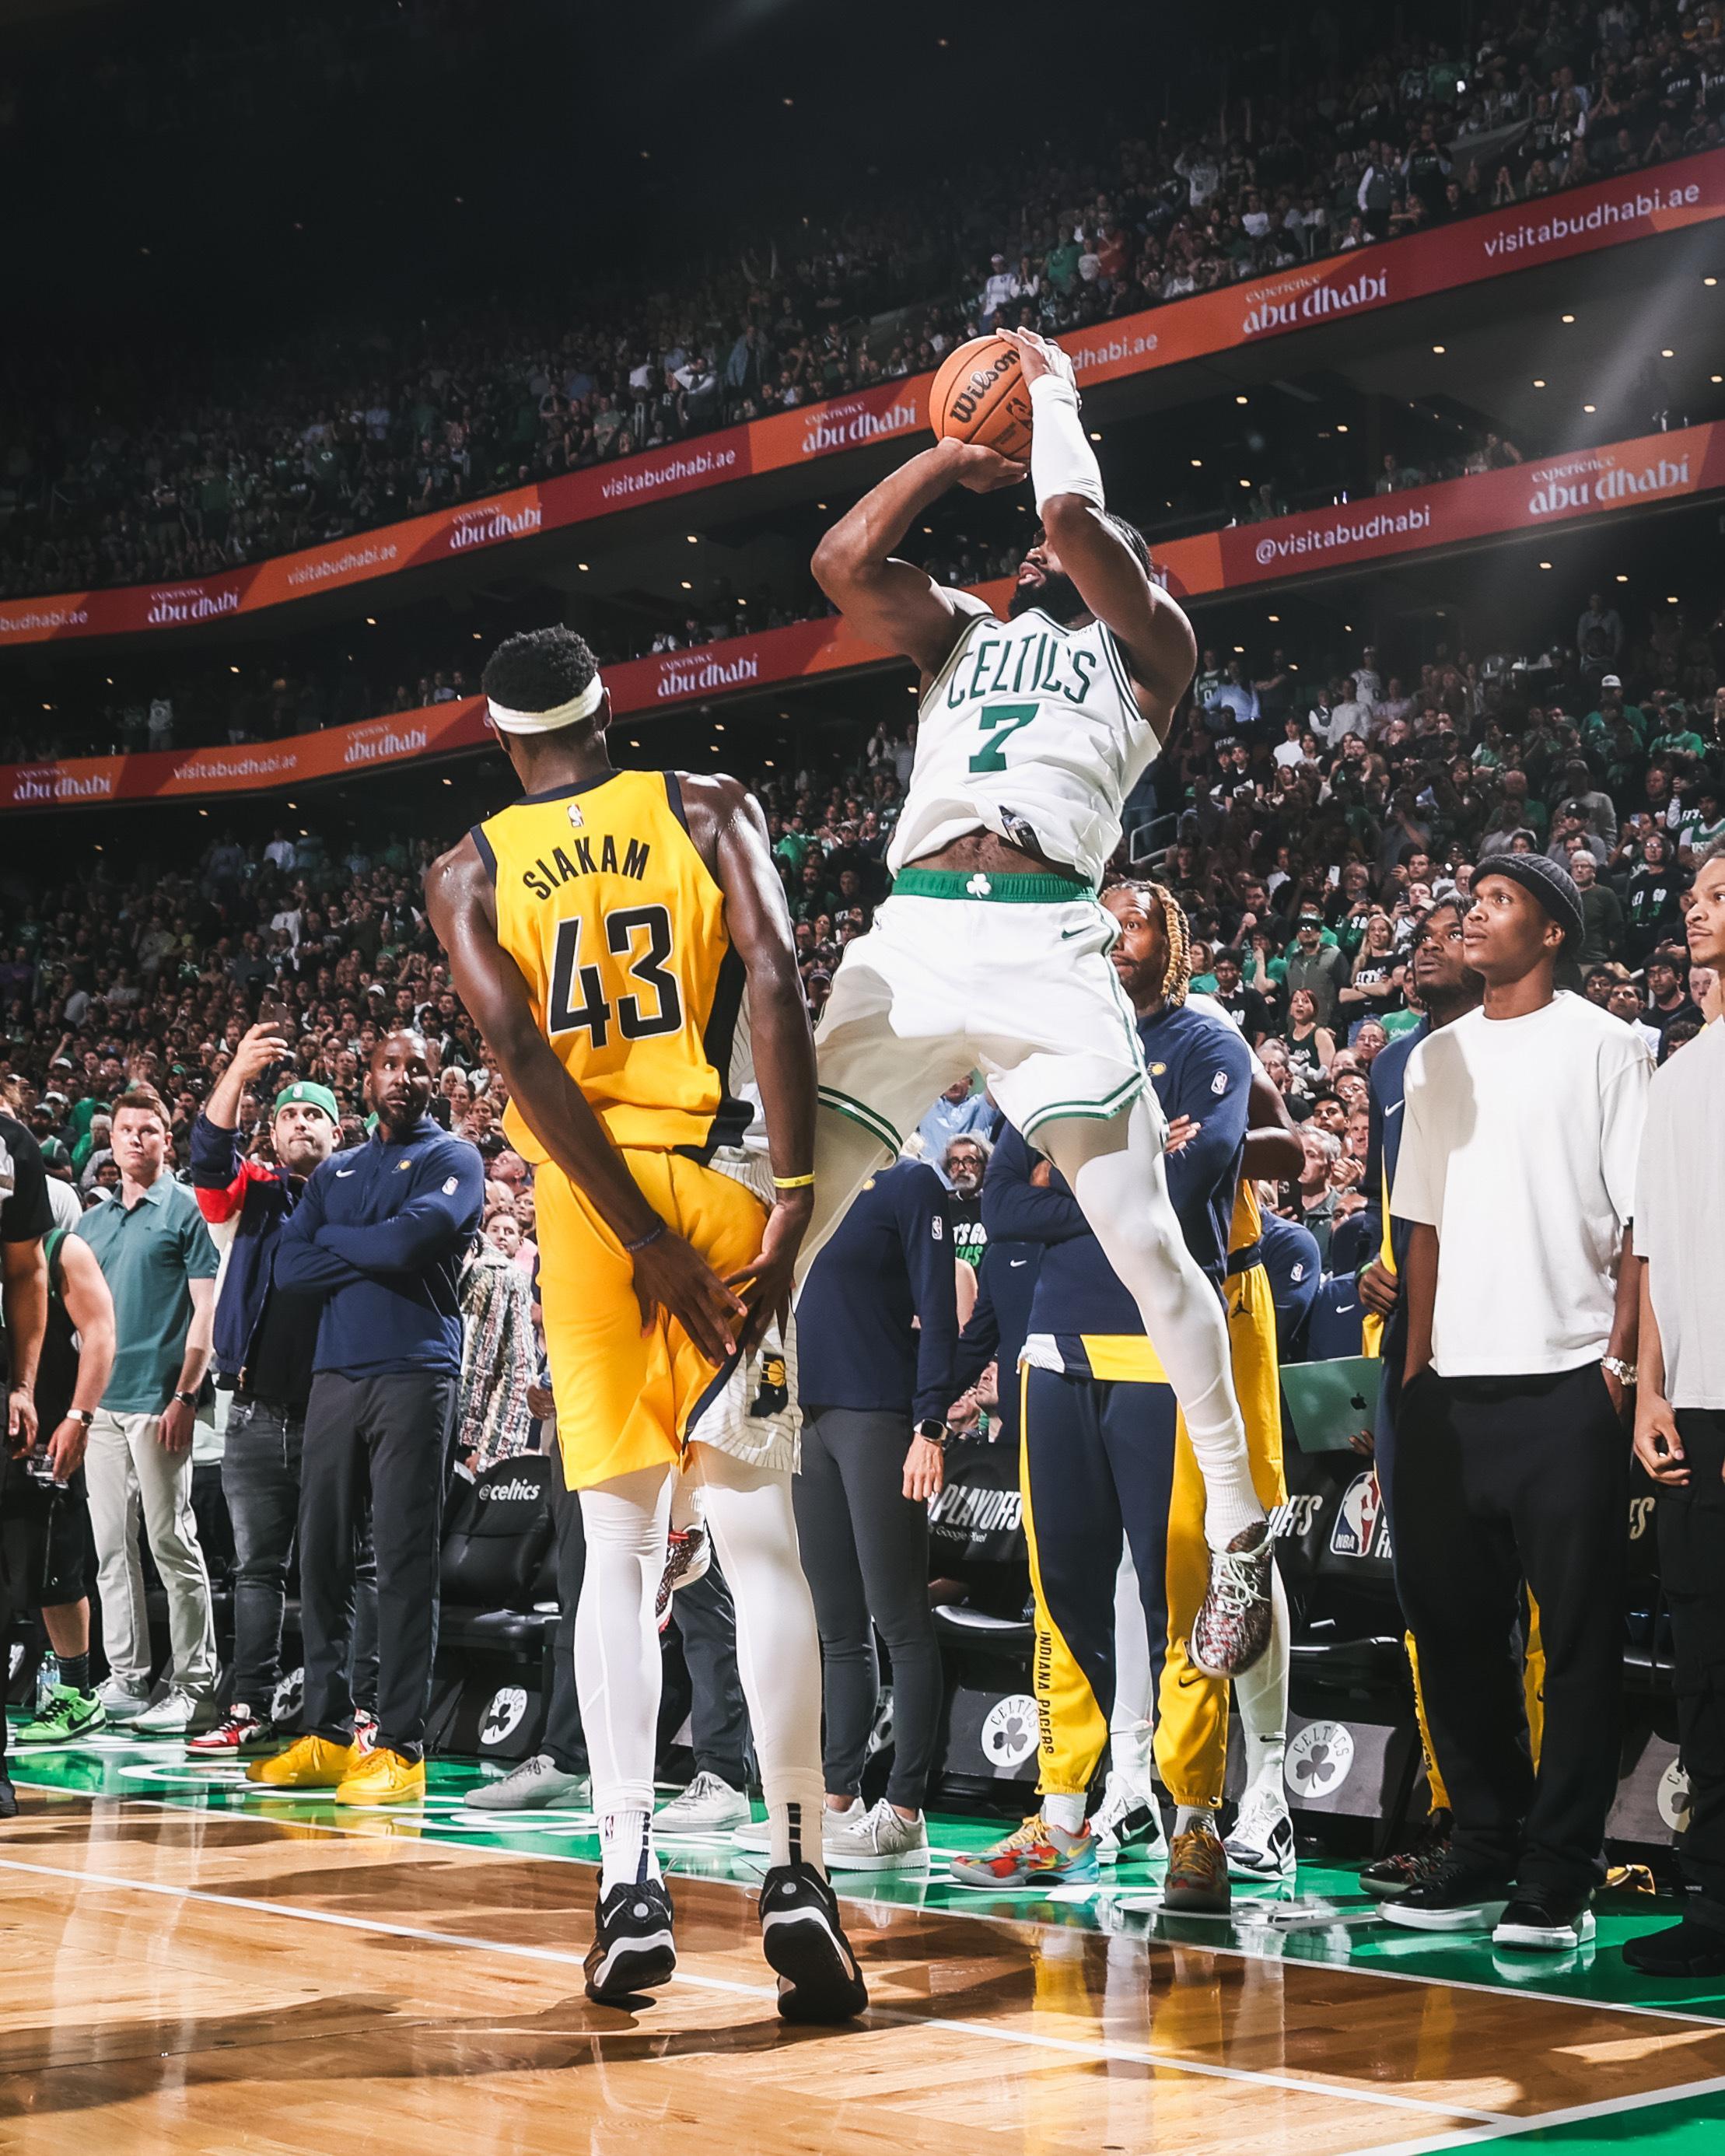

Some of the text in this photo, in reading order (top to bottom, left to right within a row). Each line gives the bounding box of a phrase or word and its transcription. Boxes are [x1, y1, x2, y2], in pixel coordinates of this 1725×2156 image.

[1484, 184, 1700, 257] visitabudhabi.ae
[1243, 268, 1387, 334] abu dhabi
[1245, 274, 1321, 304] experience
[949, 349, 1020, 423] Wilson
[802, 399, 917, 453] abu dhabi
[601, 448, 736, 499] visitabudhabi.ae
[1527, 454, 1690, 516] abu dhabi
[1531, 454, 1616, 485] experience
[450, 503, 542, 549] abu dhabi
[1255, 506, 1431, 565] @visitabudhabi
[287, 544, 397, 586] visitabudhabi.ae
[147, 586, 240, 623] abu dhabi
[657, 652, 758, 697] abu dhabi
[947, 632, 1097, 709] CELTICS
[344, 726, 428, 765] abu dhabi
[968, 702, 1040, 773] 7
[13, 773, 111, 801] abu dhabi
[173, 754, 299, 781] visitabudhabi.ae
[523, 835, 650, 901] SIAKAM
[546, 903, 686, 1051] 43
[479, 1478, 541, 1501] @celtics
[930, 1483, 1022, 1531] PLAYOFFS
[1335, 1534, 1355, 1550] NBA
[990, 1699, 1038, 1728] CELTICS
[1037, 1631, 1055, 1754] INDIANA PACERS
[1293, 1725, 1350, 1757] CELTICS
